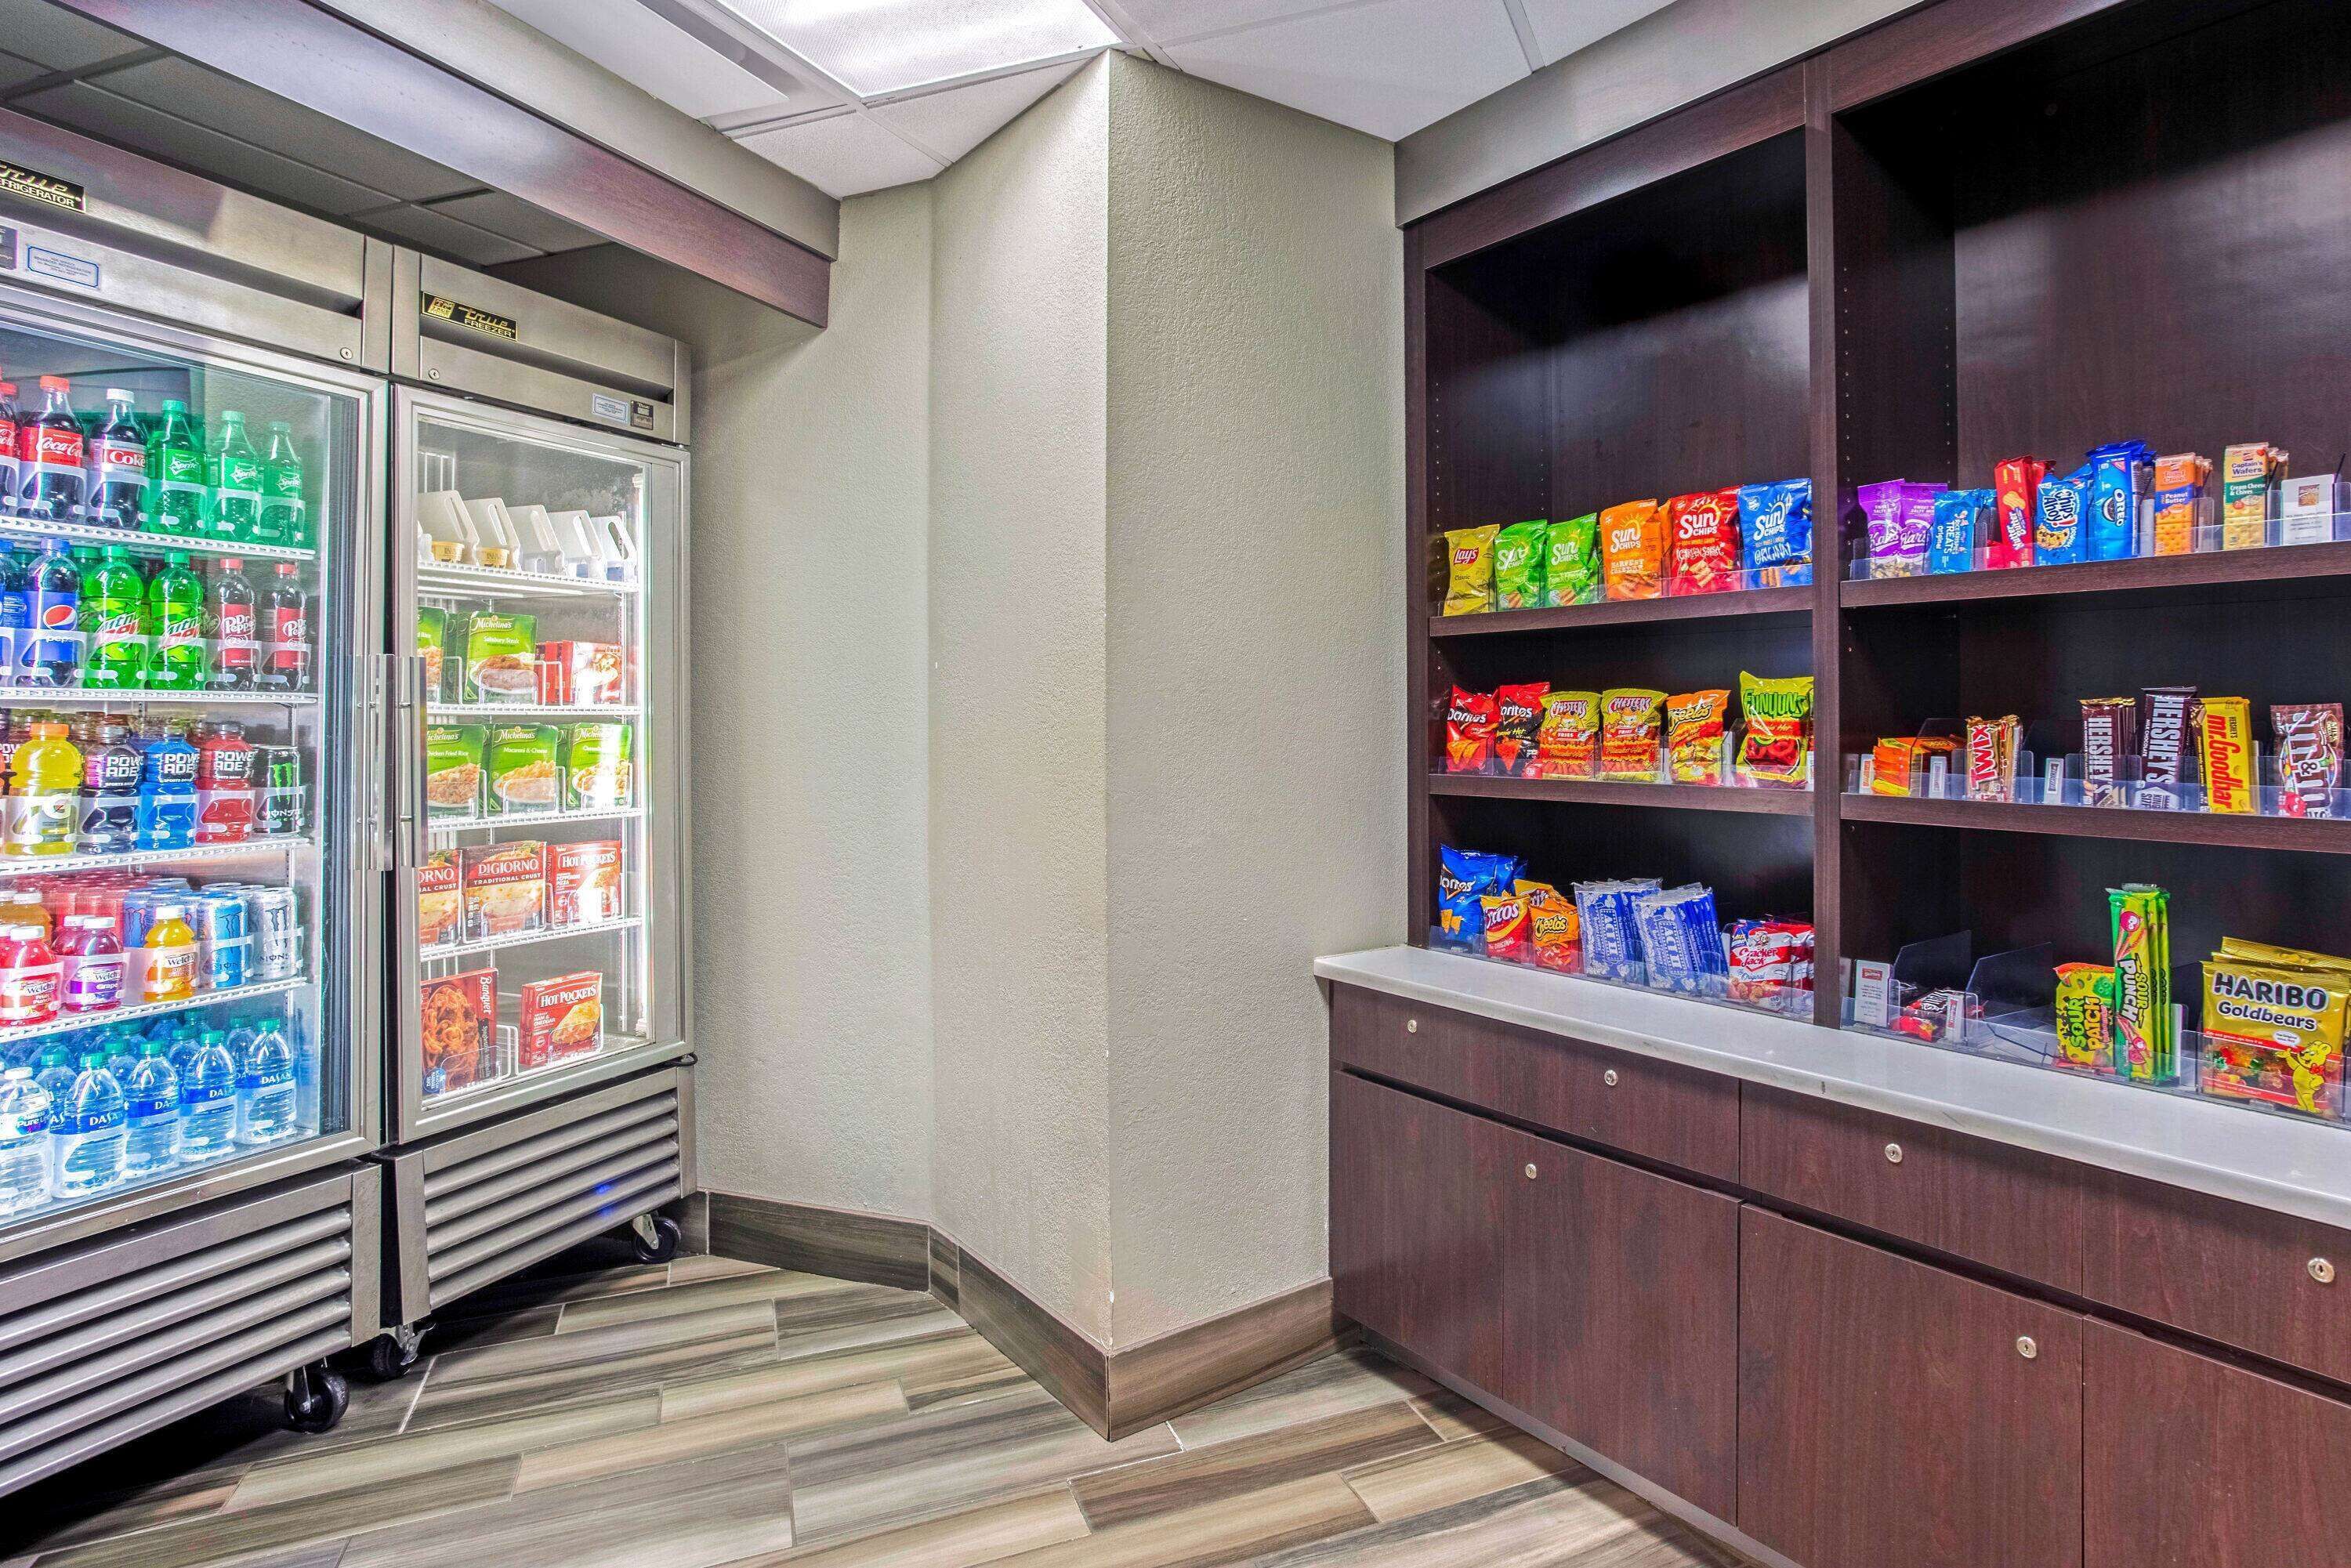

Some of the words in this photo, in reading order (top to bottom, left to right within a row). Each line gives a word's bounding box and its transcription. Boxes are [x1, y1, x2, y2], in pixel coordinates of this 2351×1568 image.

[464, 318, 512, 337] FREEZER
[2231, 461, 2263, 469] Captain's
[2055, 488, 2075, 520] Chips
[2114, 488, 2126, 527] OREO
[1693, 526, 1718, 535] CHIPS
[1763, 523, 1785, 534] CHIPS
[1943, 520, 1955, 554] TREATS
[1619, 541, 1641, 550] CHIPS
[1499, 705, 1533, 718] oritos
[1744, 689, 1807, 719] FUNYUNS
[2141, 730, 2150, 758] CHOCOLATE
[2146, 697, 2185, 785] HERSHEY'S
[1970, 724, 1998, 790] TWIX
[2208, 739, 2244, 809] Goodbar
[2152, 794, 2166, 809] KING
[433, 882, 457, 891] CRUST
[473, 876, 519, 885] TRADITIONAL
[1534, 915, 1567, 940] Cheetos
[1738, 947, 1778, 958] Cracker
[1741, 955, 1765, 968] Jack
[480, 976, 492, 1015] Banquet
[540, 994, 559, 1008] HOT
[560, 985, 597, 1003] POCKETS
[2118, 958, 2139, 1023] PUNCH
[2135, 972, 2150, 1009] SOUR
[2212, 972, 2327, 1012] HARIBO
[2067, 997, 2087, 1048] SOUR
[2085, 996, 2102, 1051] PATCH
[2218, 1000, 2317, 1030] Goldbears
